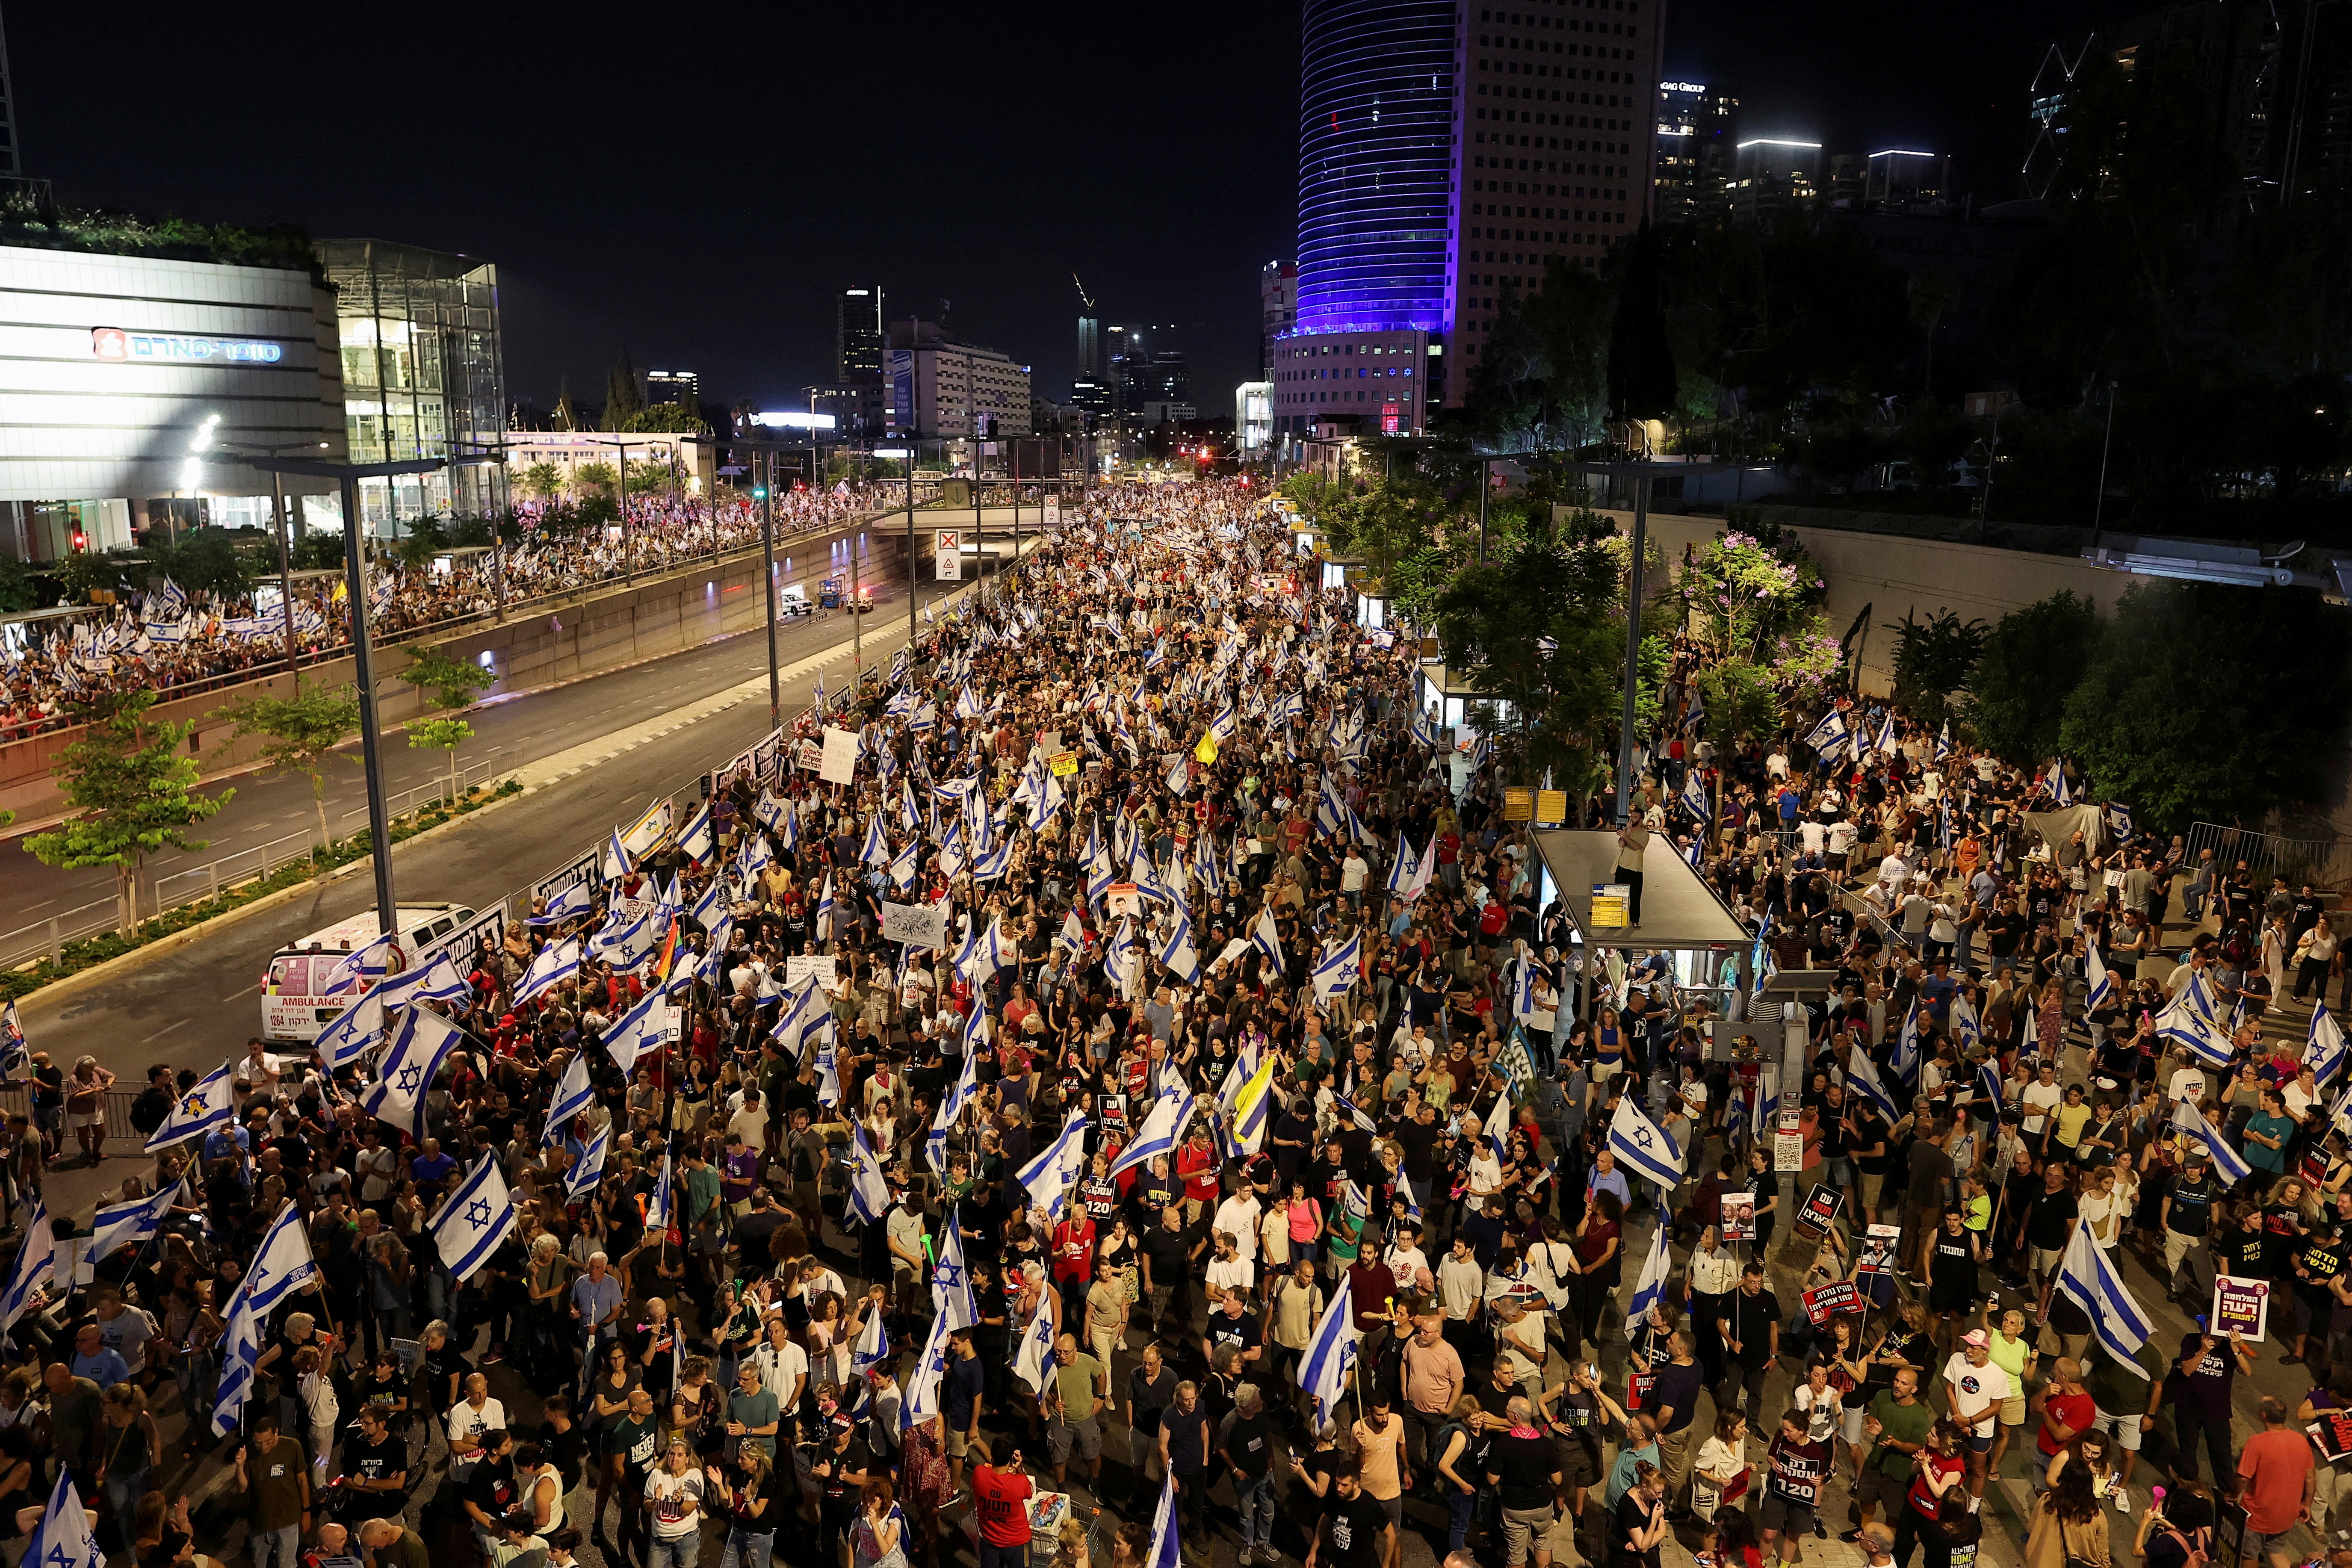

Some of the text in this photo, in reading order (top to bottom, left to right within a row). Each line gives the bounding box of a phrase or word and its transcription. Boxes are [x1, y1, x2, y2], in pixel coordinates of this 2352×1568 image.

[1679, 82, 1705, 93] GROUP
[133, 337, 281, 363] סופר-פארם
[282, 997, 345, 1009] AMBULANCE
[270, 1016, 309, 1027] ירקון 1264
[1634, 1017, 1647, 1031] PO
[1633, 1027, 1646, 1038] LO
[1107, 1100, 1117, 1109] עם
[1103, 1109, 1121, 1118] חטוף
[1103, 1118, 1124, 1128] בארצו
[1201, 1177, 1216, 1186] אשם
[1088, 1188, 1112, 1196] עסקה
[1819, 1192, 1833, 1205] עם
[1086, 1202, 1110, 1214] 120
[1812, 1200, 1833, 1217] חטוף
[1940, 1244, 1965, 1257] תתנגדו
[2243, 1240, 2261, 1253] דחה
[2243, 1251, 2260, 1261] כשיו
[2308, 1246, 2338, 1266] הדחה
[2304, 1253, 2335, 1274] עכשיו
[1816, 1285, 1853, 1301] תהיו גולדה.
[2223, 1293, 2257, 1304] המלחמה
[1810, 1294, 1853, 1312] קחו אחריות!
[2222, 1302, 2256, 1314] רעה
[2222, 1312, 2255, 1322] לחטופים
[1216, 1330, 1243, 1347] חופשי
[631, 1433, 655, 1457] NEVER
[1780, 1462, 1817, 1479] עסקה
[1789, 1458, 1806, 1471] רק
[989, 1489, 1001, 1498] עם
[1778, 1478, 1814, 1498] 120
[979, 1499, 1011, 1513] חטוף
